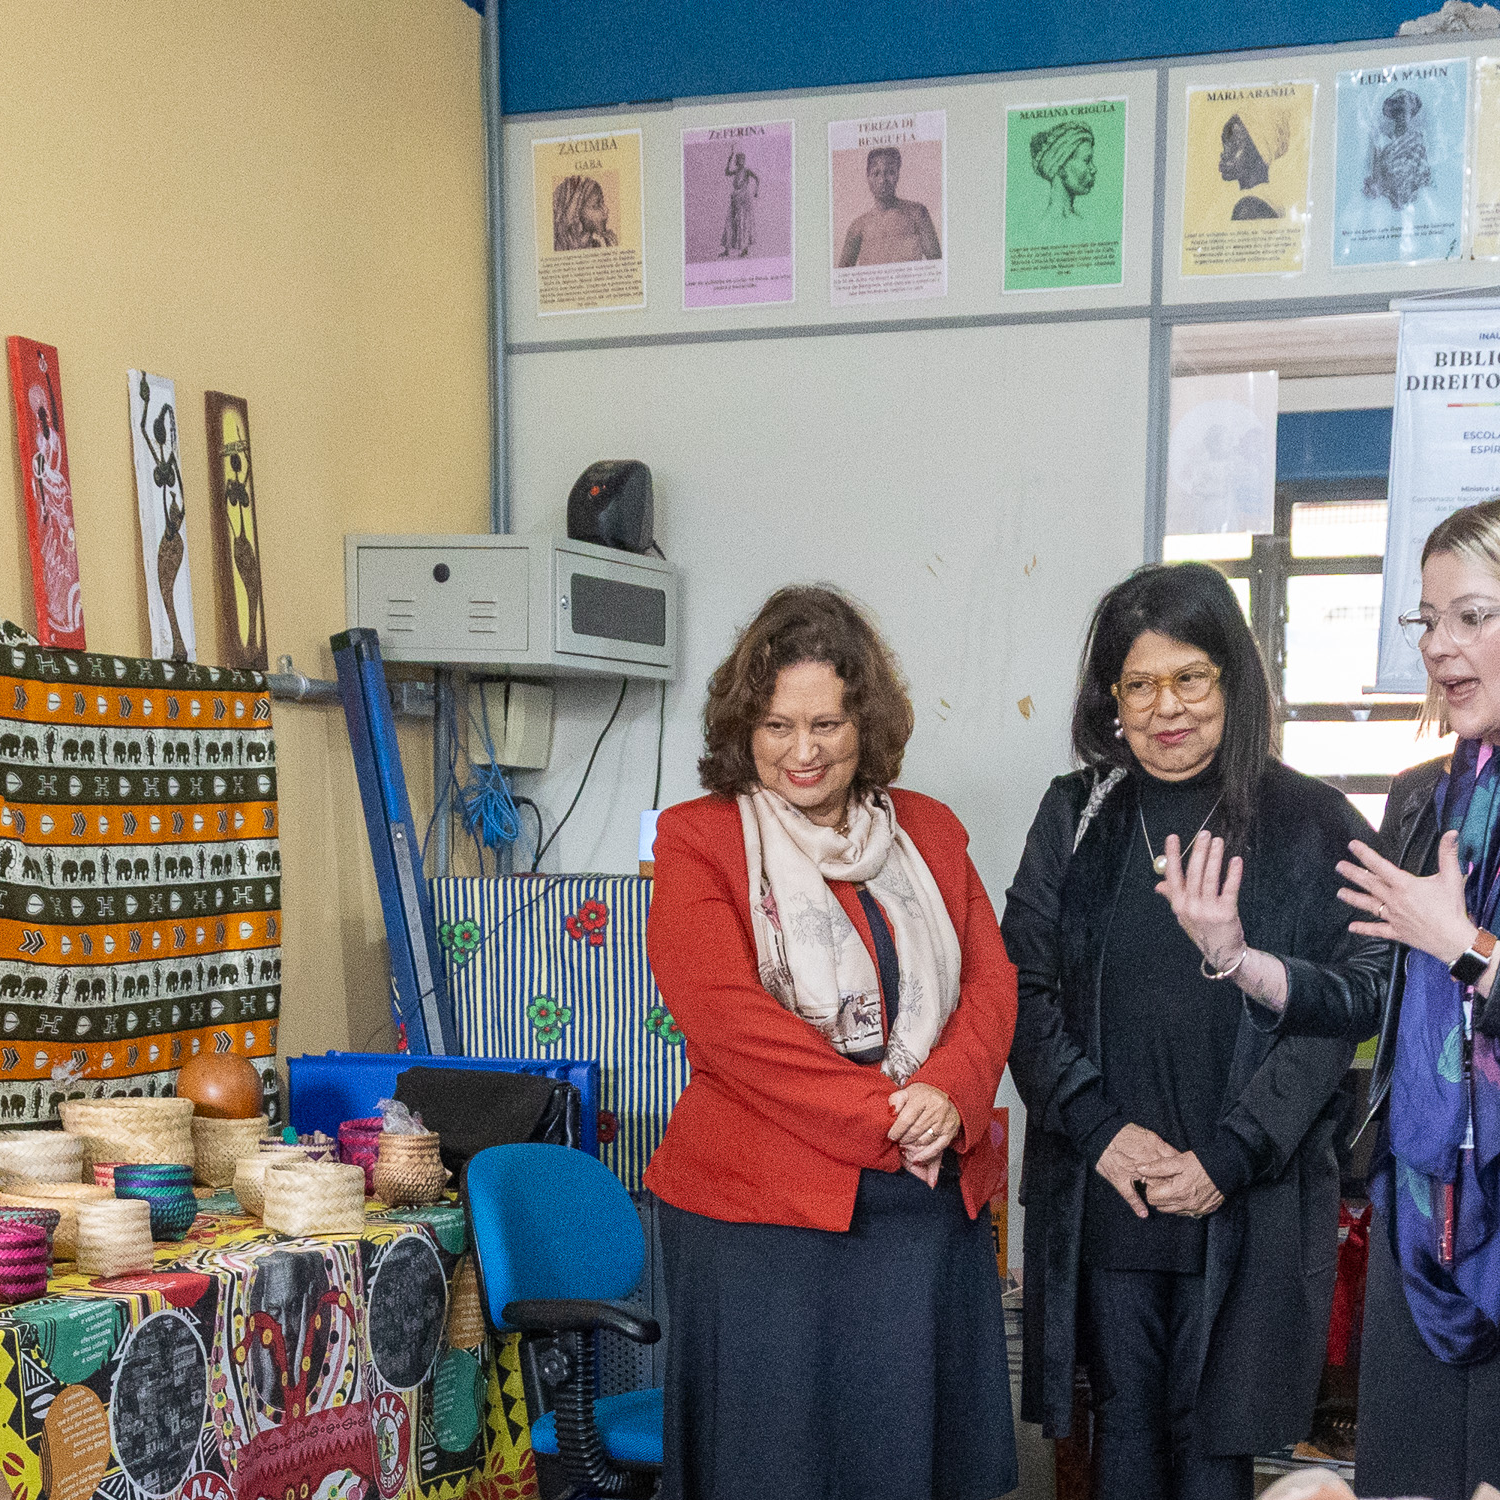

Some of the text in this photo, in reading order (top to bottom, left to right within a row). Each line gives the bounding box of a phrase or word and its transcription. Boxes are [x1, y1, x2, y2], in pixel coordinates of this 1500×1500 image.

[1207, 86, 1296, 102] MARIA ARANHA
[1019, 103, 1117, 120] MARIANA CRIOULA
[858, 117, 915, 133] TEREZA DE
[558, 137, 619, 156] ZACIMBA
